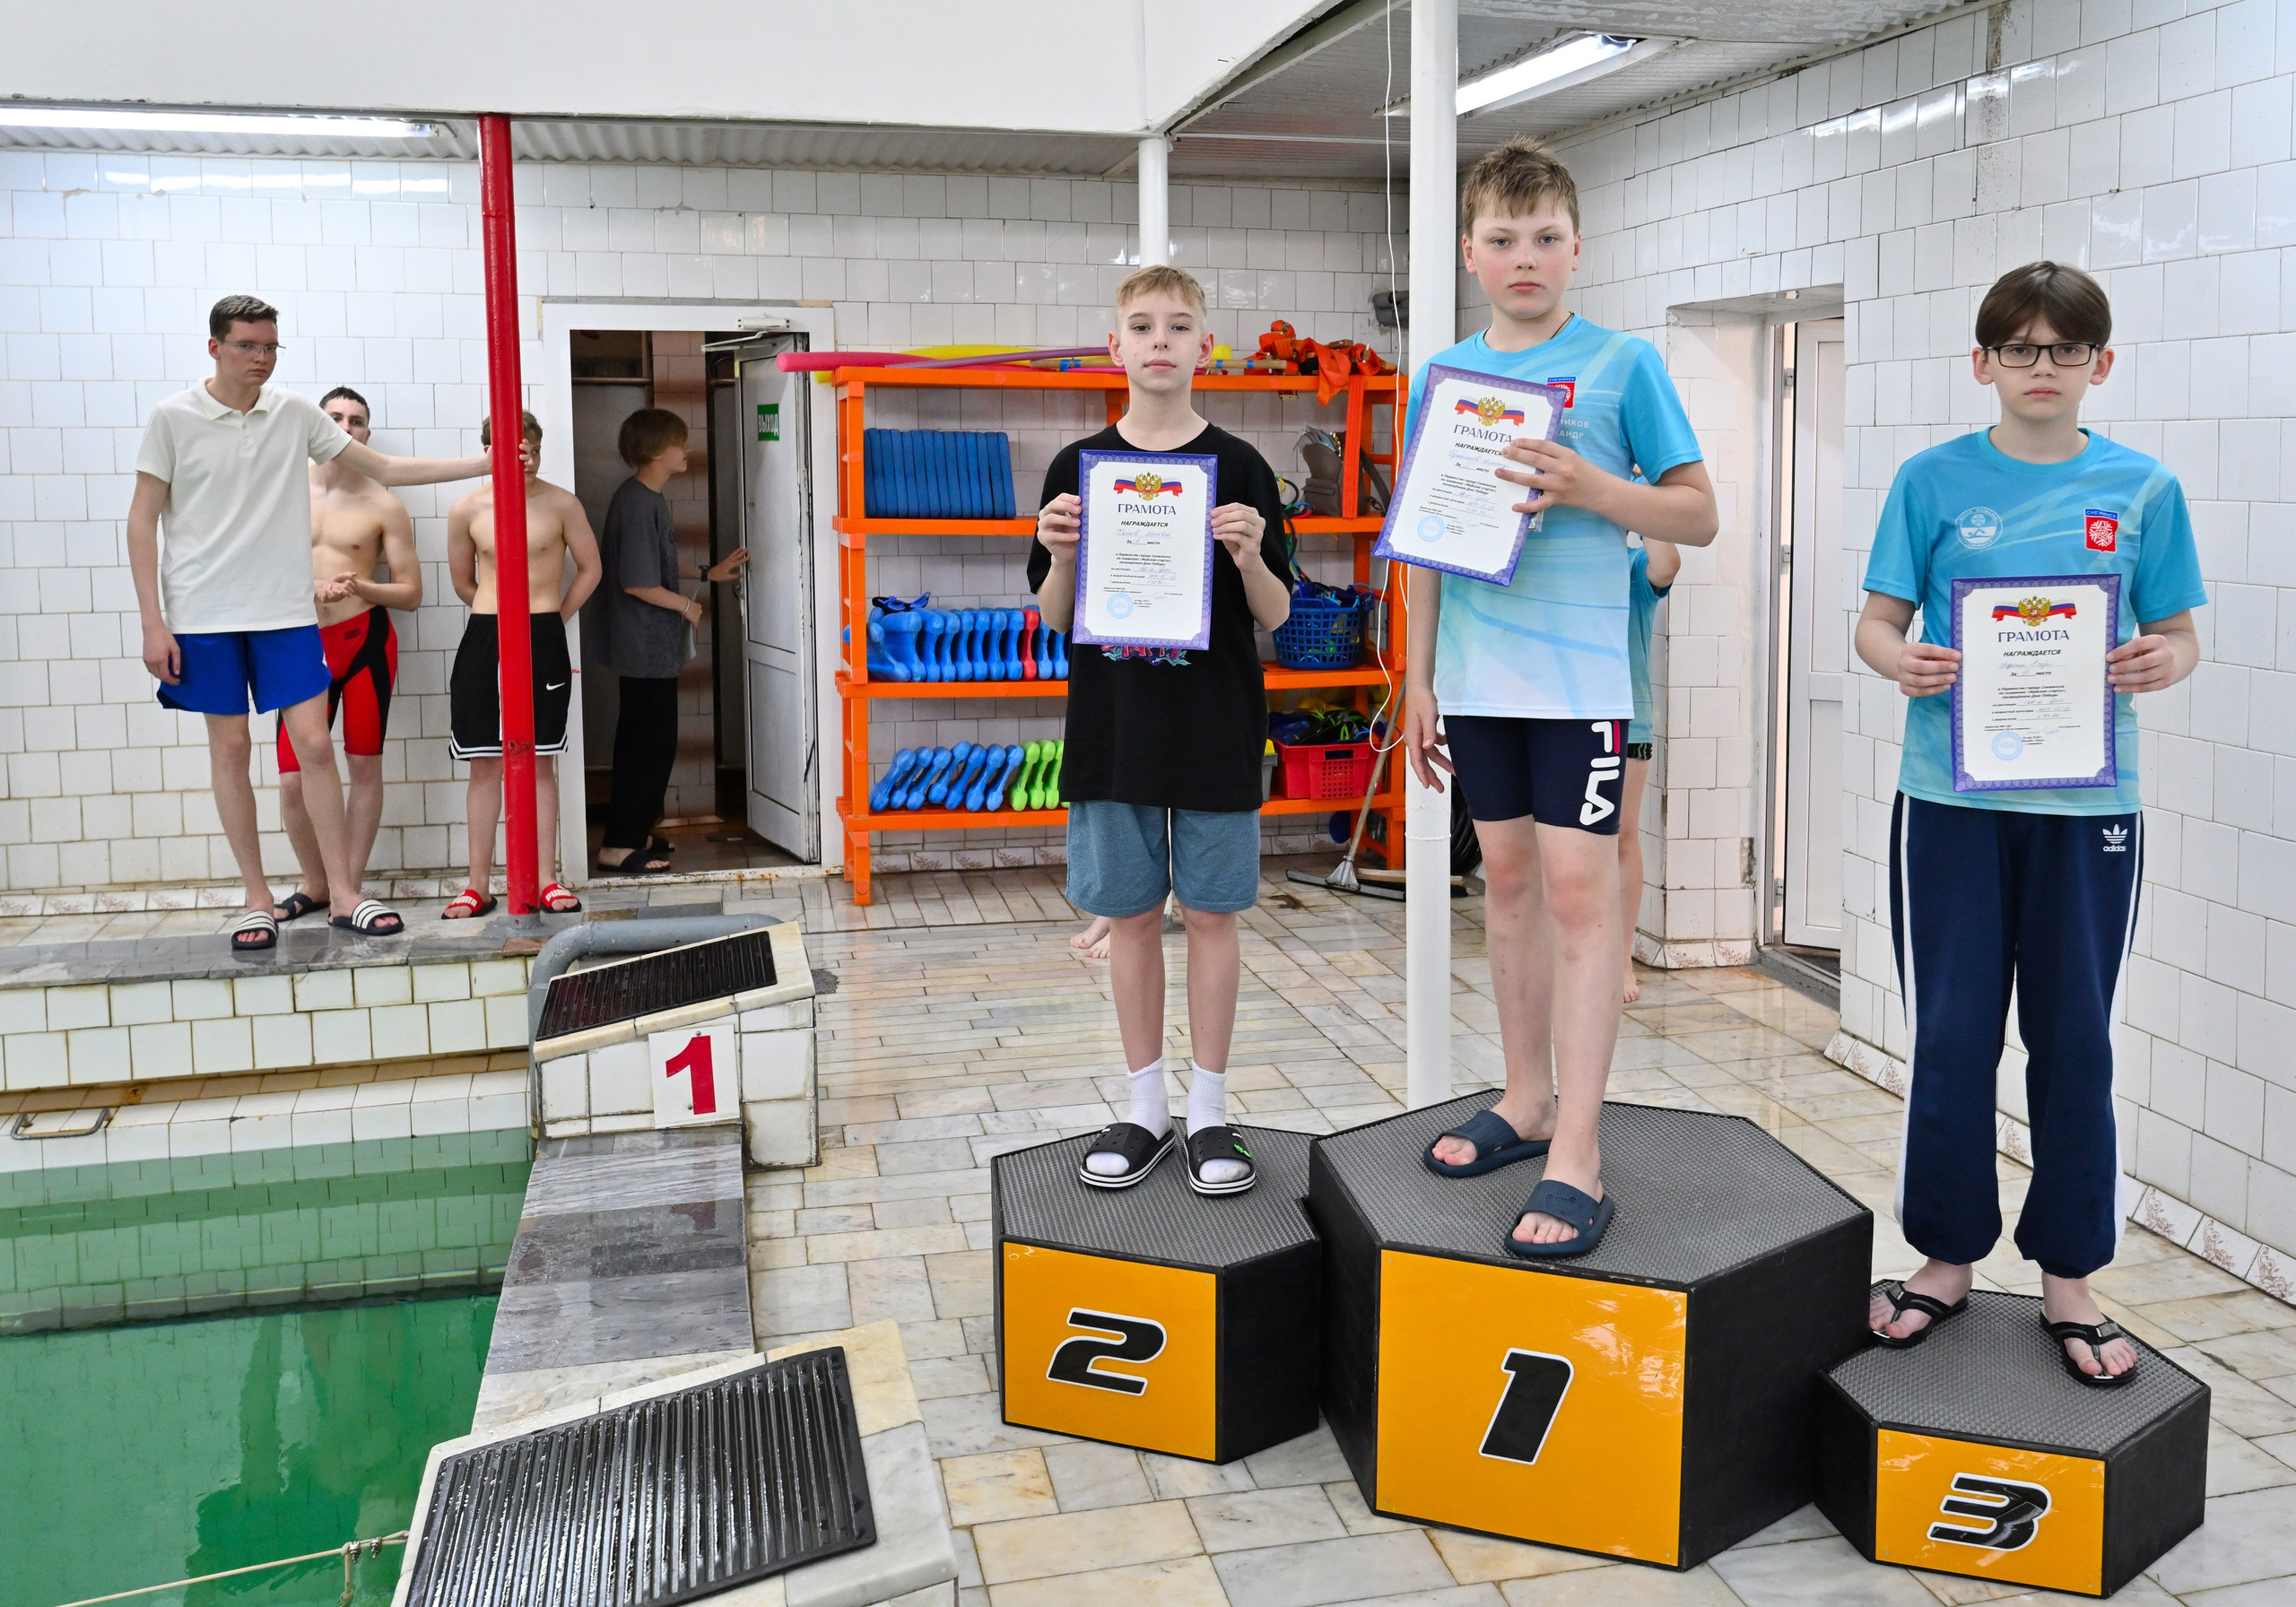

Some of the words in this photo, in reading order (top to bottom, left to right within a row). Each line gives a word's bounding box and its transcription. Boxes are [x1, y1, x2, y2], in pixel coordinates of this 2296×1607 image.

[759, 414, 778, 436] ВЫХОД
[1453, 424, 1512, 444] ГРАМОТА
[1556, 430, 1584, 439] АНДР
[1118, 504, 1176, 515] ГРАМОТА
[2087, 510, 2116, 518] СНЕЖИНСК
[1997, 630, 2070, 642] ГРАМОТА
[1579, 720, 1620, 825] FILA
[665, 1035, 716, 1115] 1
[1046, 1307, 1167, 1396] 2
[1479, 1347, 1574, 1465] 1
[1926, 1472, 2051, 1551] 3
